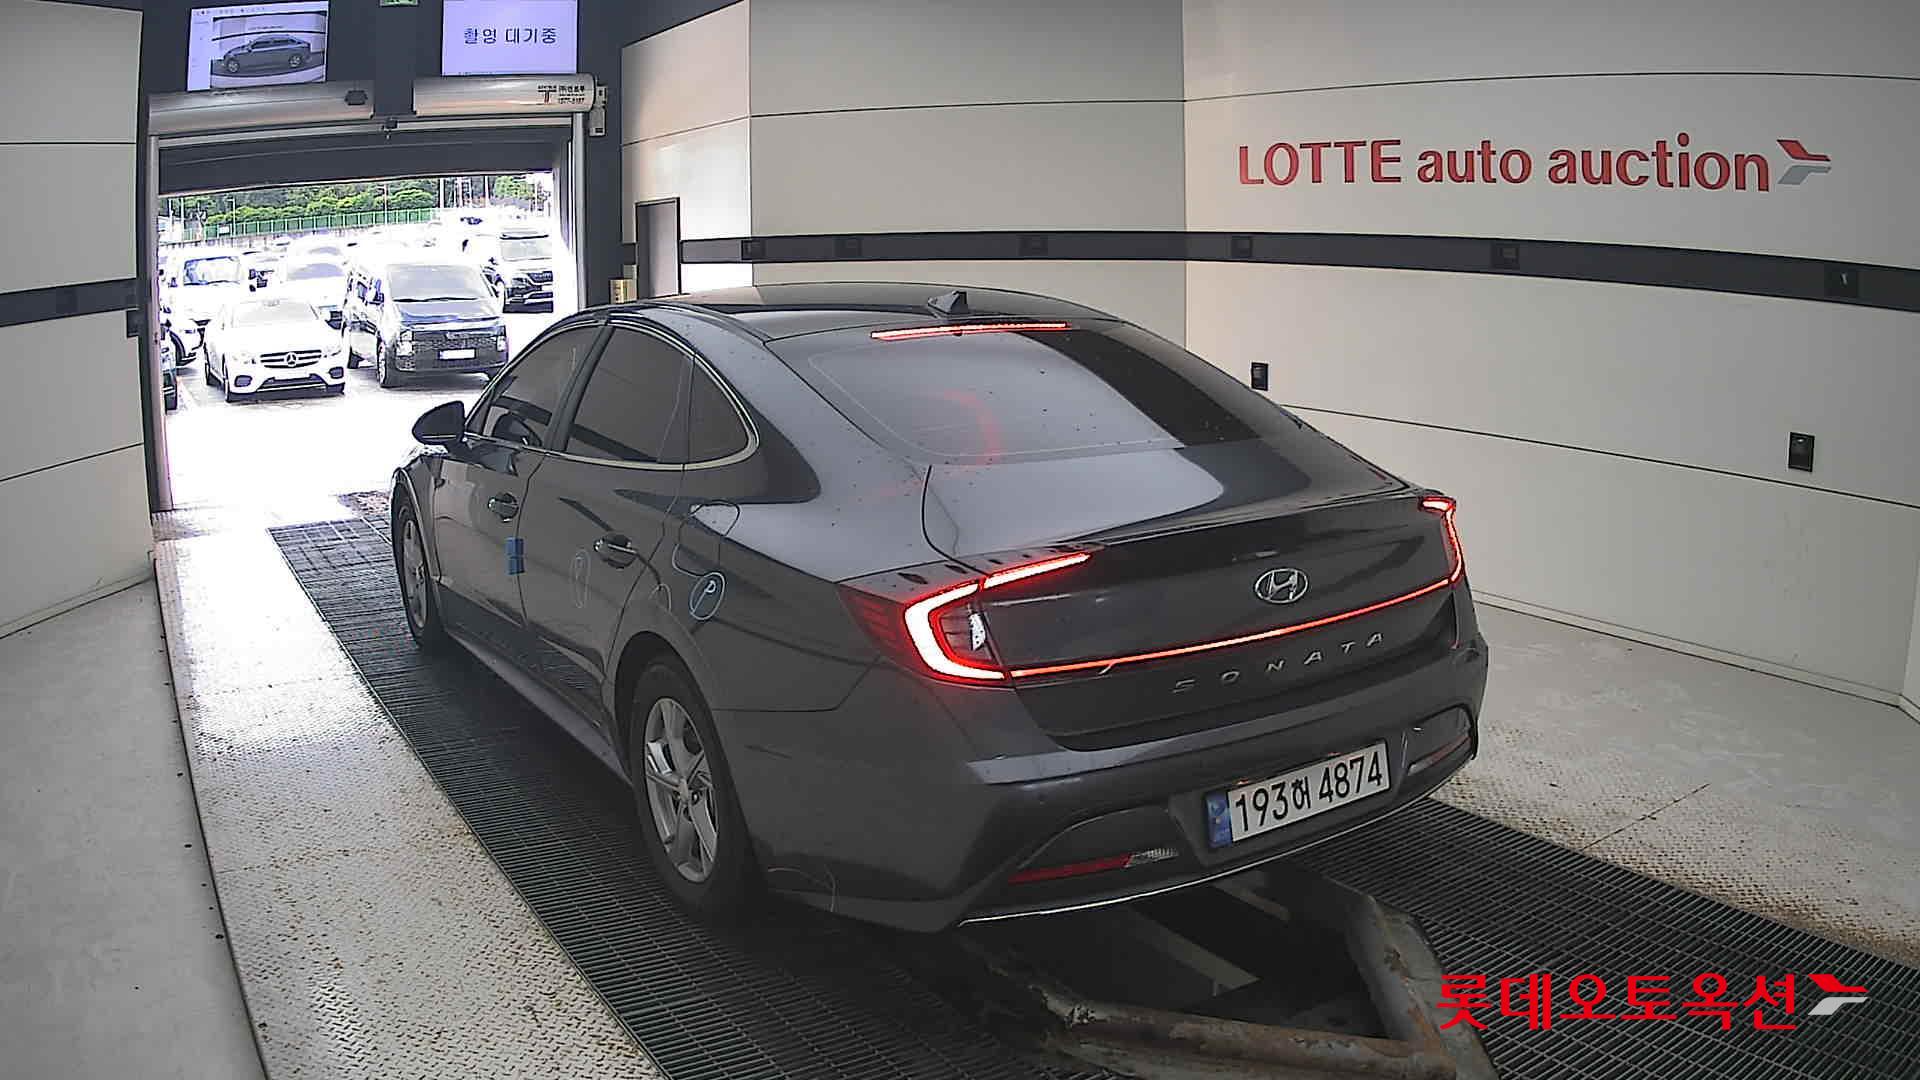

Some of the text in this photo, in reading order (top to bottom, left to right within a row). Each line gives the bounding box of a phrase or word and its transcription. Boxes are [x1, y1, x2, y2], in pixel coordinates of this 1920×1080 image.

[505, 27, 557, 44] 대기중
[1238, 132, 1770, 192] LOTTE auto auction
[1172, 632, 1384, 693] SONATA
[1235, 751, 1383, 832] 193허 4874
